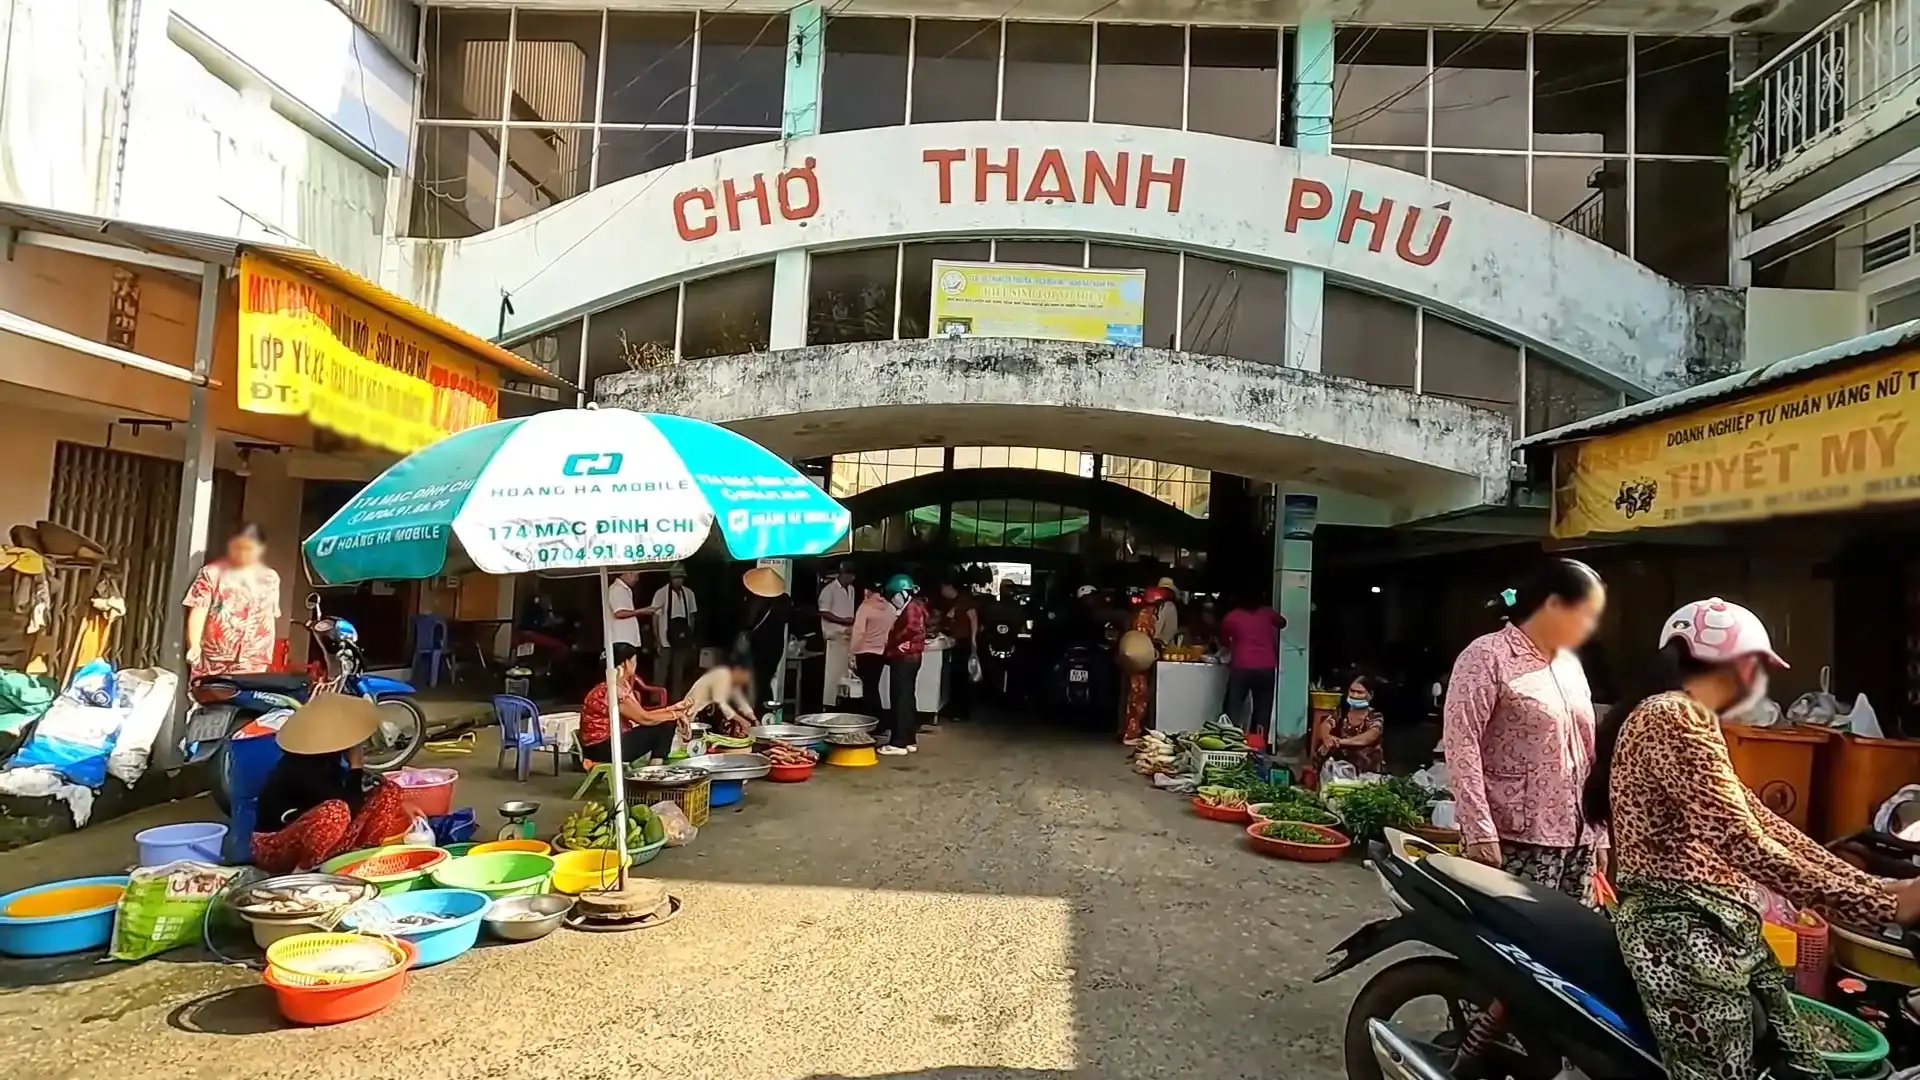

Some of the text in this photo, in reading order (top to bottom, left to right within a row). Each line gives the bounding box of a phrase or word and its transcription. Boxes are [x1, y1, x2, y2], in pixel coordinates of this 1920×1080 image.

[673, 146, 1455, 266] CHỢ THẠNH PHÚ
[250, 333, 285, 379] LỢP
[1667, 424, 1705, 447] DOANH
[1707, 411, 1755, 437] NGHIỆP
[1758, 403, 1778, 427] TƯ
[1779, 393, 1822, 421] NHÂN
[1826, 382, 1872, 411] VÀNG
[1875, 370, 1903, 399] NỮ
[1665, 432, 1800, 500] TUYẾT
[1820, 411, 1910, 478] MỸ
[612, 479, 689, 493] MOBILE
[394, 525, 440, 541] MOBILE
[488, 524, 528, 541] 174
[656, 517, 694, 533] CHI
